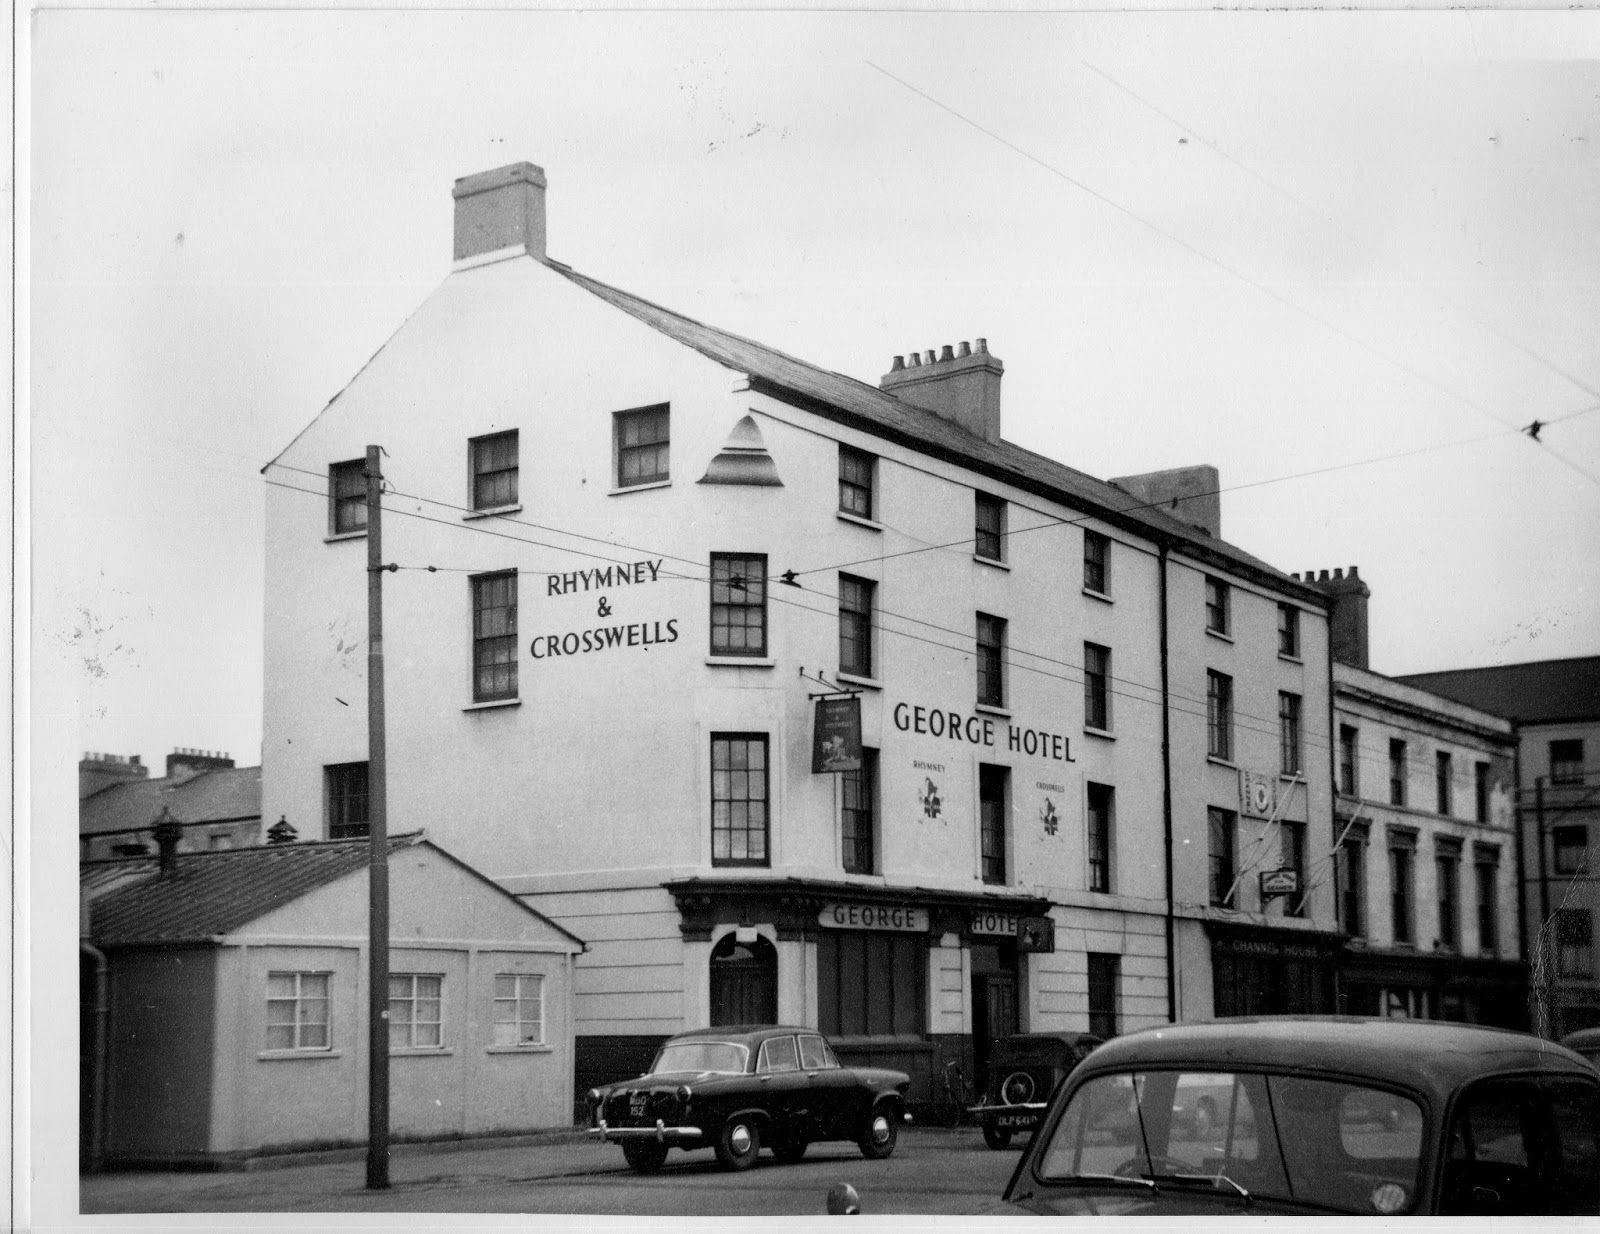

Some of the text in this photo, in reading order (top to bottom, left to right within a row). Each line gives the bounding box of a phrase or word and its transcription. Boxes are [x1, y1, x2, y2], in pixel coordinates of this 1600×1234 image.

[547, 559, 663, 596] RHYMNEY
[597, 596, 612, 617] &
[530, 619, 679, 659] CROSSWELLS
[893, 702, 1076, 763] GEORGE HOTEL
[913, 760, 946, 773] RHYMNEY
[834, 905, 1016, 932] GEORGE HOTE
